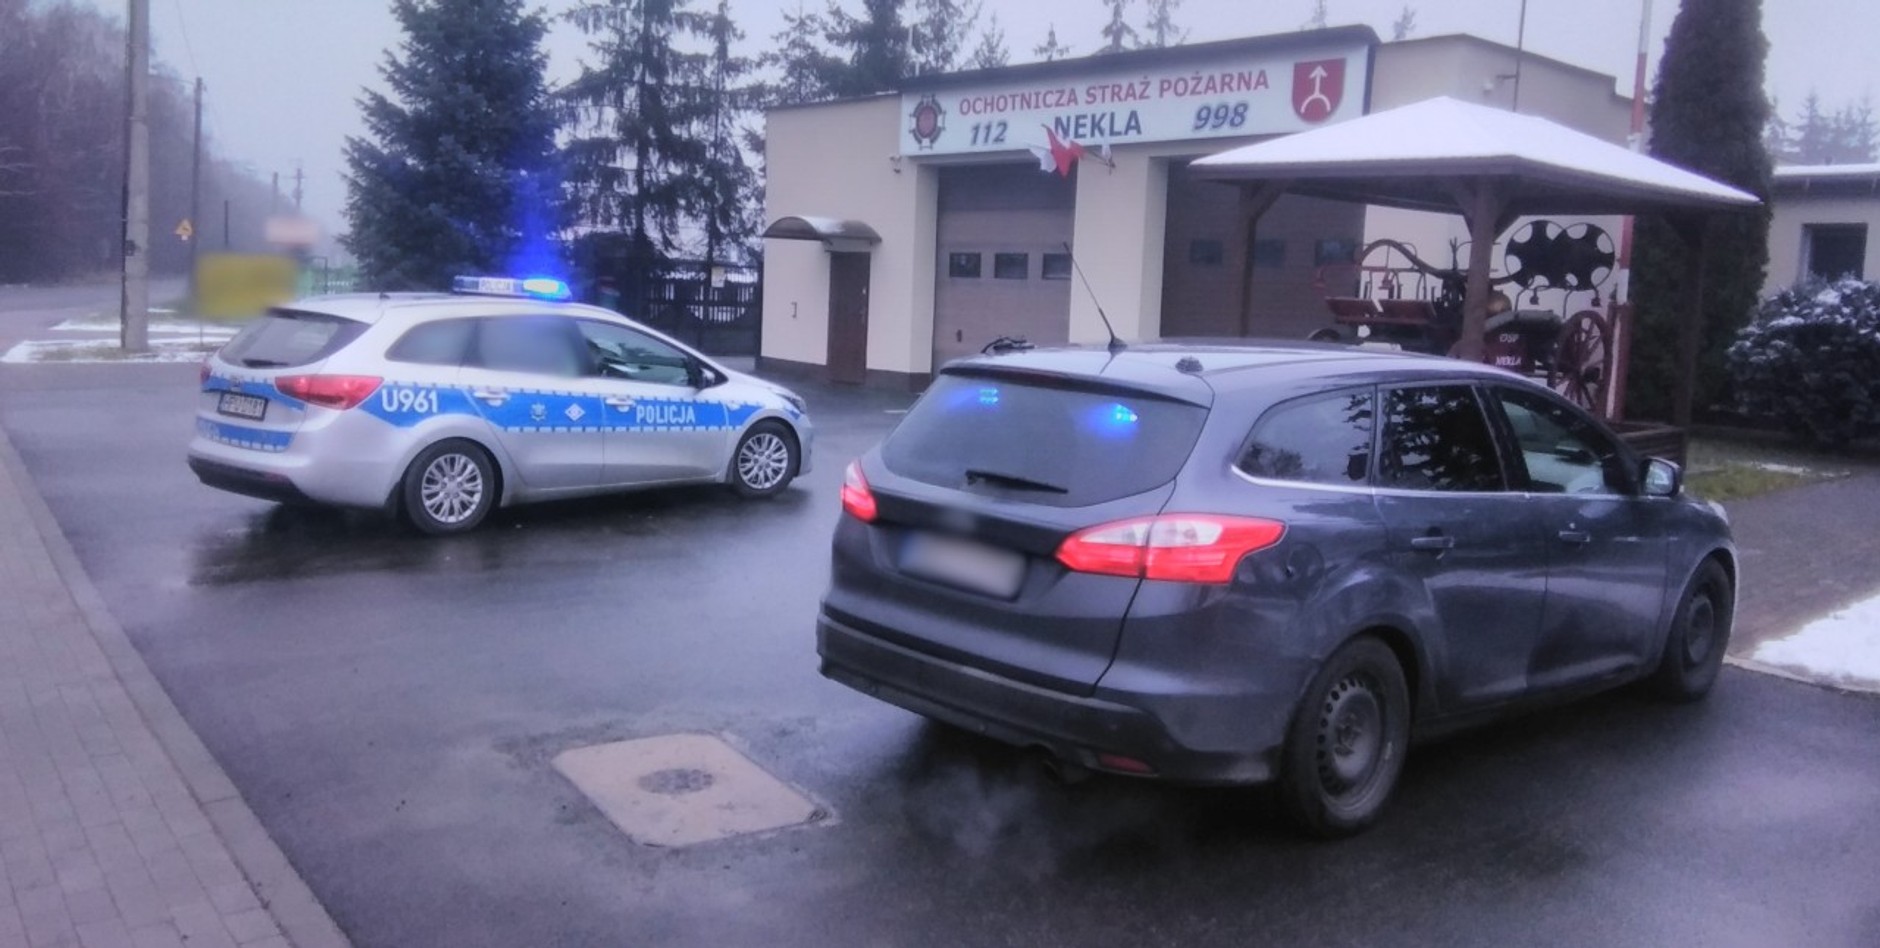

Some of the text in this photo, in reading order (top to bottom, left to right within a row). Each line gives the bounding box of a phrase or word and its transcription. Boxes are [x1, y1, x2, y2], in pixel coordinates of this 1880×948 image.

[959, 69, 1270, 116] OCHOTNICZA STRAŻ POŻARNA
[1054, 110, 1142, 140] NEKLA
[1193, 102, 1249, 131] 998
[970, 120, 1008, 146] 112
[381, 388, 438, 414] U961
[636, 403, 696, 426] POLICJA
